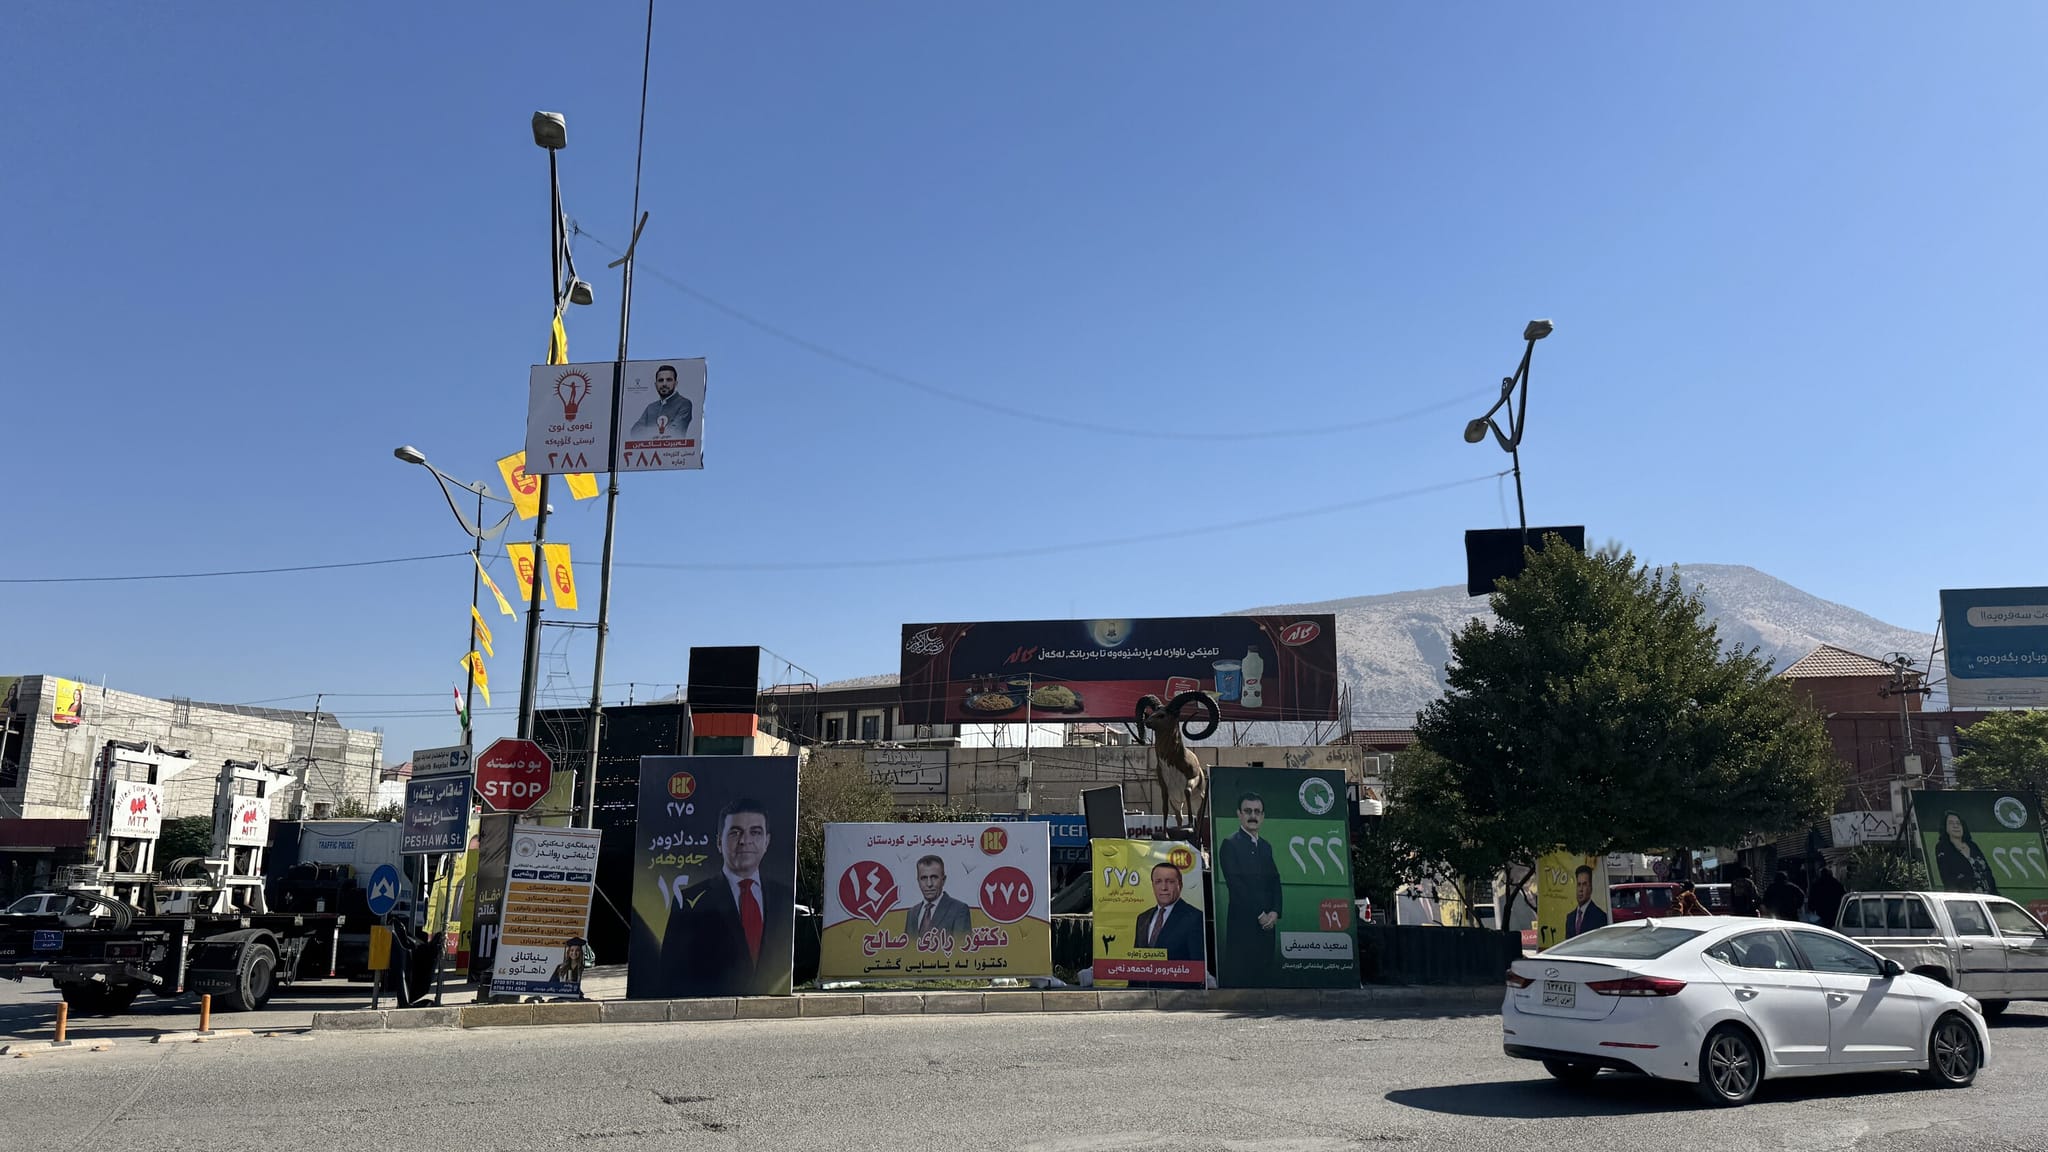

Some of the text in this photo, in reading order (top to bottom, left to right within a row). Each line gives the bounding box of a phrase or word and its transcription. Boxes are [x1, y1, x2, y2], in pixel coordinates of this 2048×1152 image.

[2021, 651, 2048, 664] وبارە
[484, 781, 542, 798] STOP
[666, 802, 695, 817] ٢٧٥
[1126, 824, 1152, 838] pple
[319, 841, 355, 849] TRAFFIC POLICE
[404, 834, 448, 848] PESHAWA
[867, 834, 975, 848] پارتی دیموکراتی کوردستان
[1289, 836, 1344, 876] ٢٢٢
[1993, 846, 2047, 879] ٢٢٢
[1103, 866, 1140, 887] ٢٧٥
[984, 882, 1030, 905] ٢٧٥
[1325, 910, 1342, 928] ١٩
[863, 929, 908, 956] صالح
[1102, 934, 1116, 956] ٣
